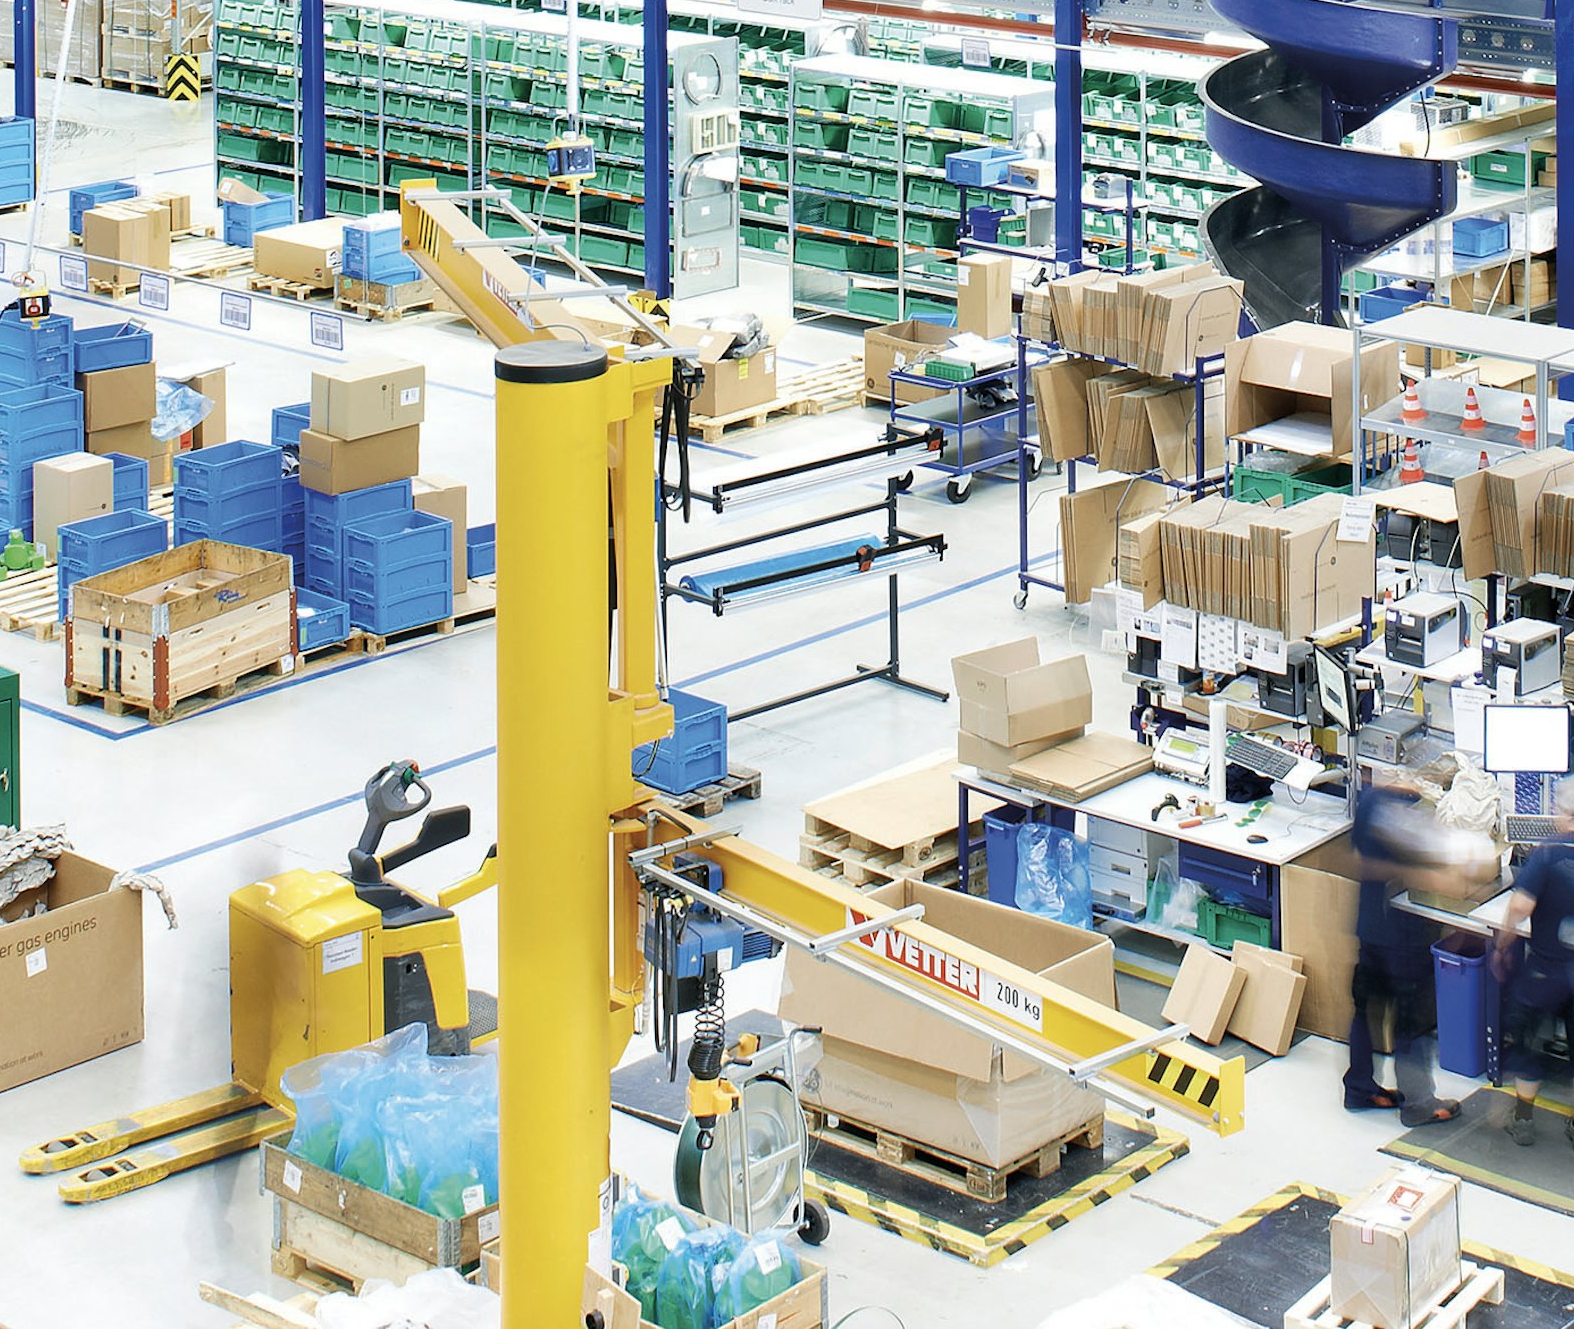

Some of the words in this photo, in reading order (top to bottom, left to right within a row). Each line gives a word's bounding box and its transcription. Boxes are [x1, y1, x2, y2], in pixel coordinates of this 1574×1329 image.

[16, 935, 41, 956] gas
[45, 916, 97, 942] engines
[889, 929, 978, 996] VETTER
[997, 982, 1019, 1008] 200
[1024, 997, 1040, 1021] kg
